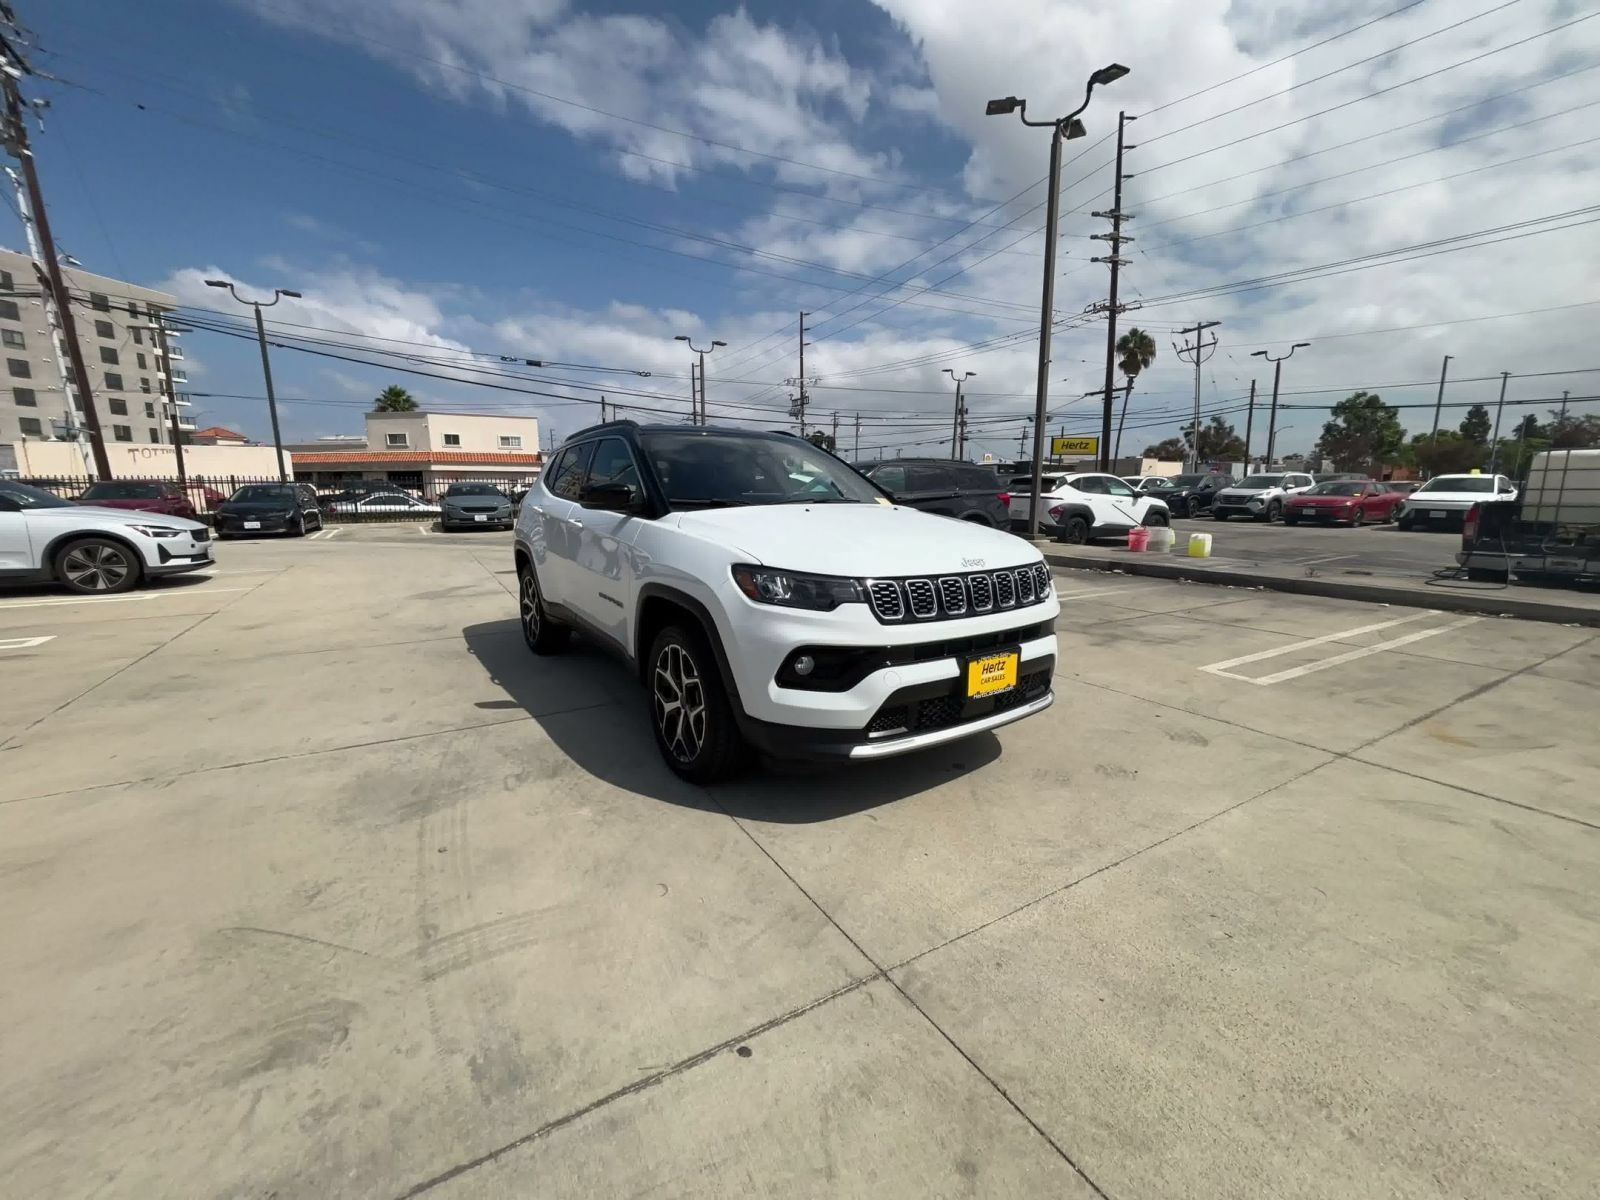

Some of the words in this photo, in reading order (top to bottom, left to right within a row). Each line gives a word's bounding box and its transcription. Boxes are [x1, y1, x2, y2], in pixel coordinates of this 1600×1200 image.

[1061, 441, 1089, 450] Hertz
[961, 557, 986, 568] Jeep
[981, 660, 1006, 675] Hertz
[981, 677, 991, 685] CAR
[991, 674, 1006, 682] SALES
